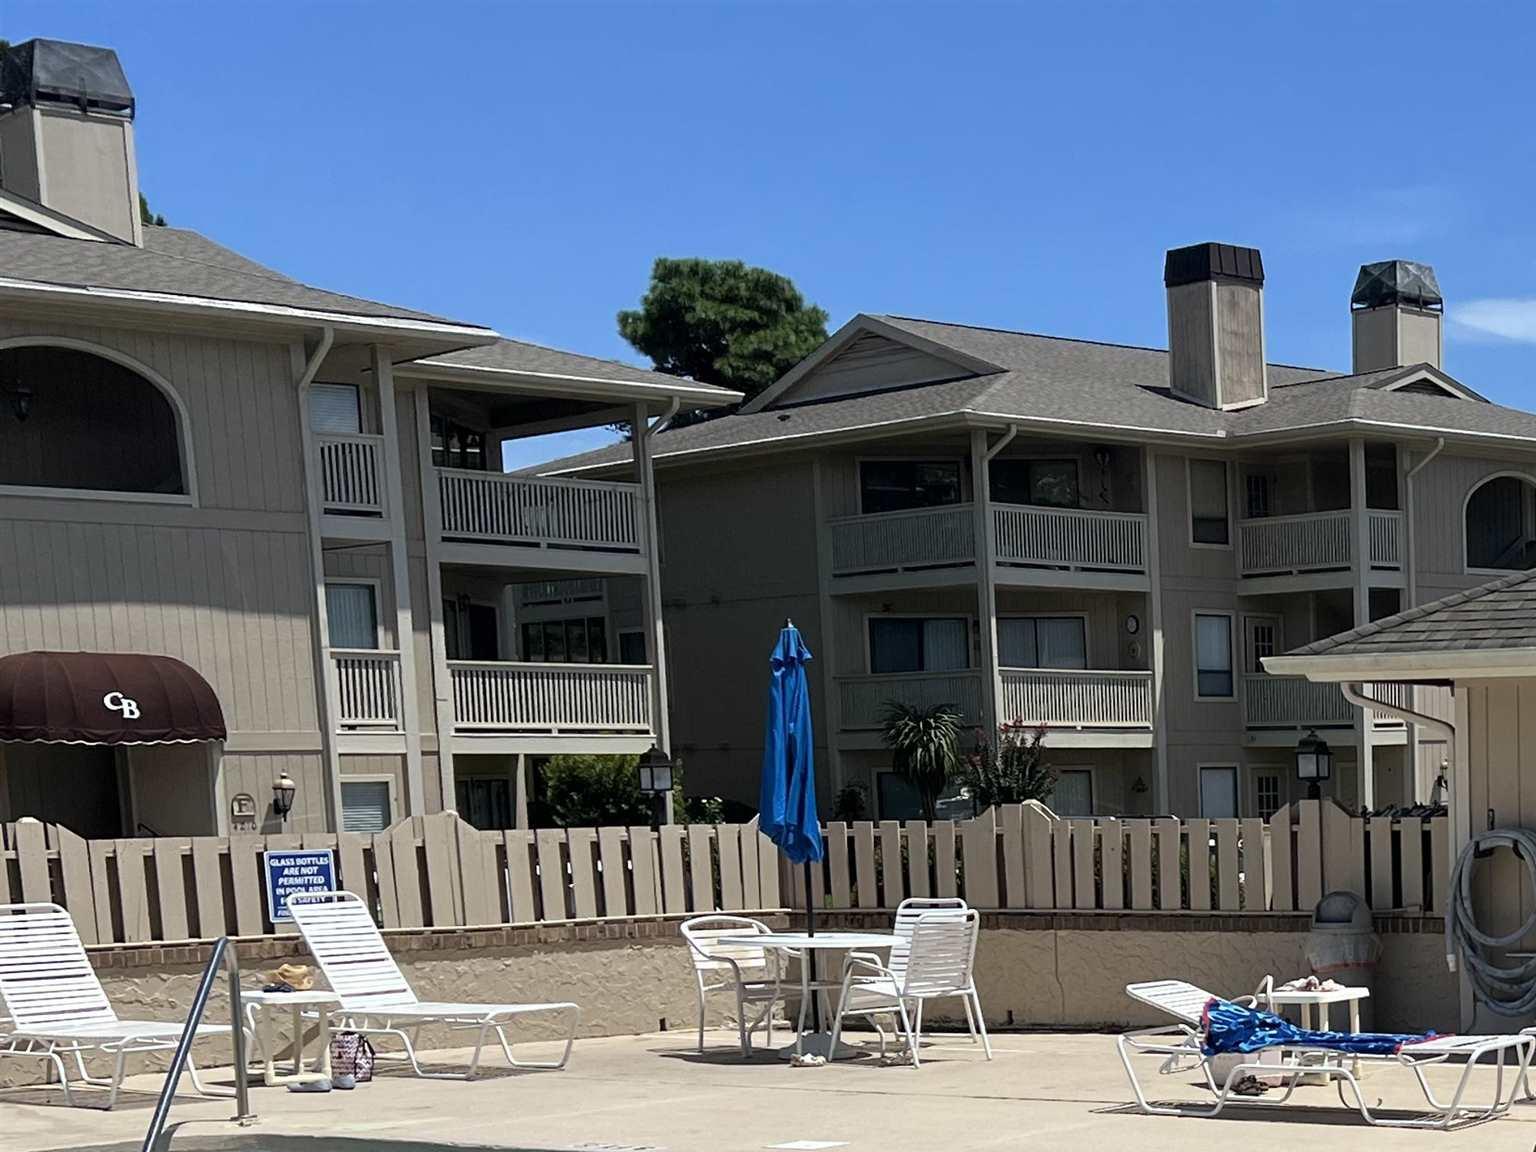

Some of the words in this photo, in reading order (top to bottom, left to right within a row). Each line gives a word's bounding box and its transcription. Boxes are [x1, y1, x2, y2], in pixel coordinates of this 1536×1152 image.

[103, 691, 141, 719] CB
[269, 858, 295, 867] GLASS
[295, 856, 329, 866] BOTTLES
[282, 867, 300, 876] ARE
[300, 866, 319, 875] NOT
[278, 876, 325, 886] PERMITTED
[275, 887, 285, 896] IN
